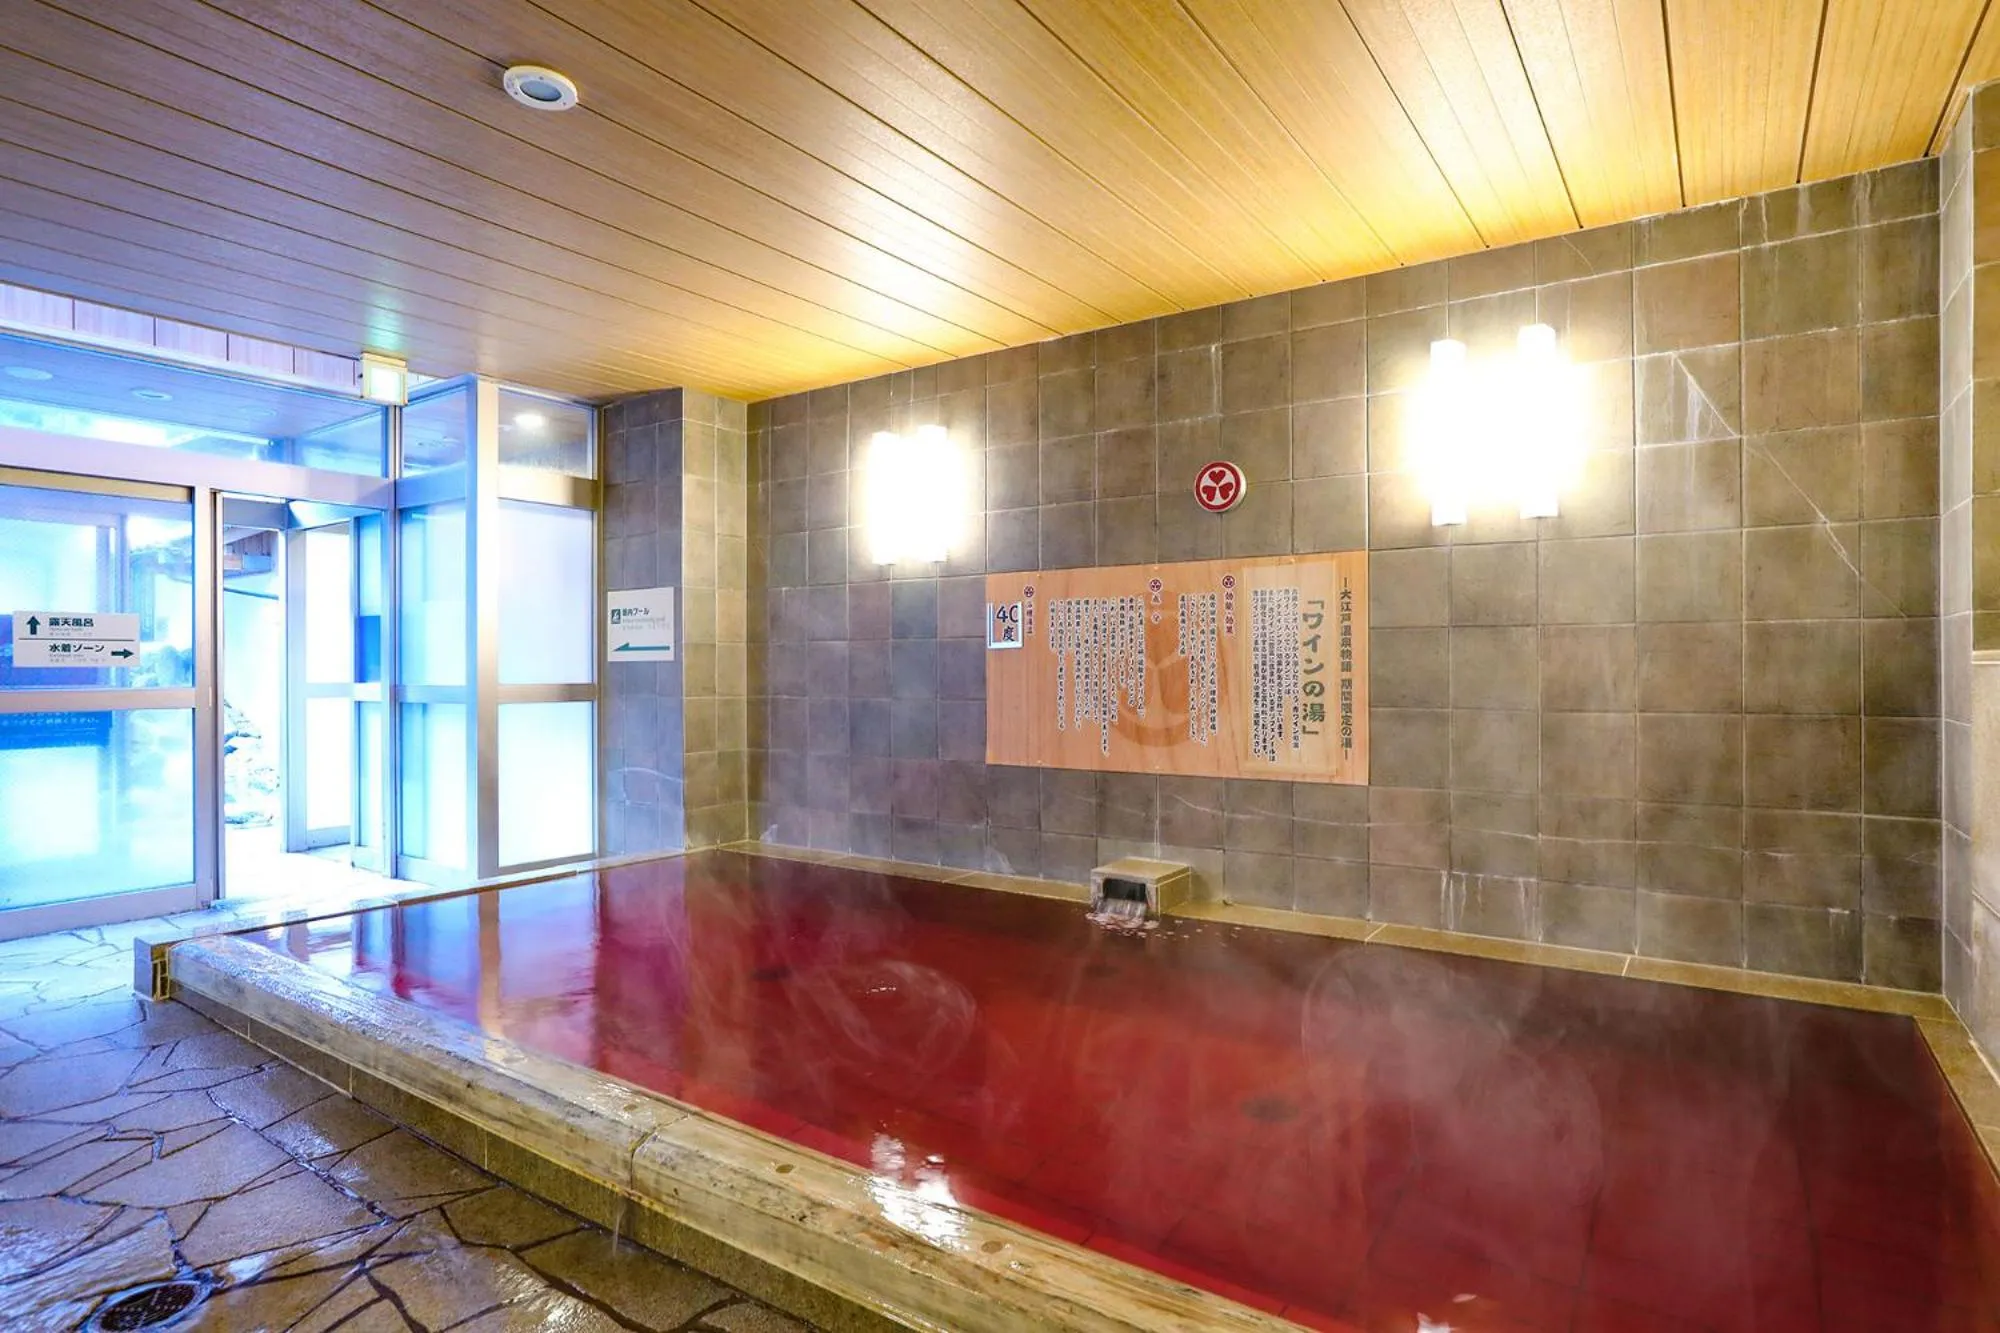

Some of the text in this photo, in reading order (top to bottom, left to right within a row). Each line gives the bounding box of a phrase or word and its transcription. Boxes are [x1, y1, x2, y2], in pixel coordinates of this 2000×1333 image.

[48, 617, 95, 628] 露天風呂
[1003, 625, 1016, 642] 度
[48, 643, 105, 653] 水着ゾーン
